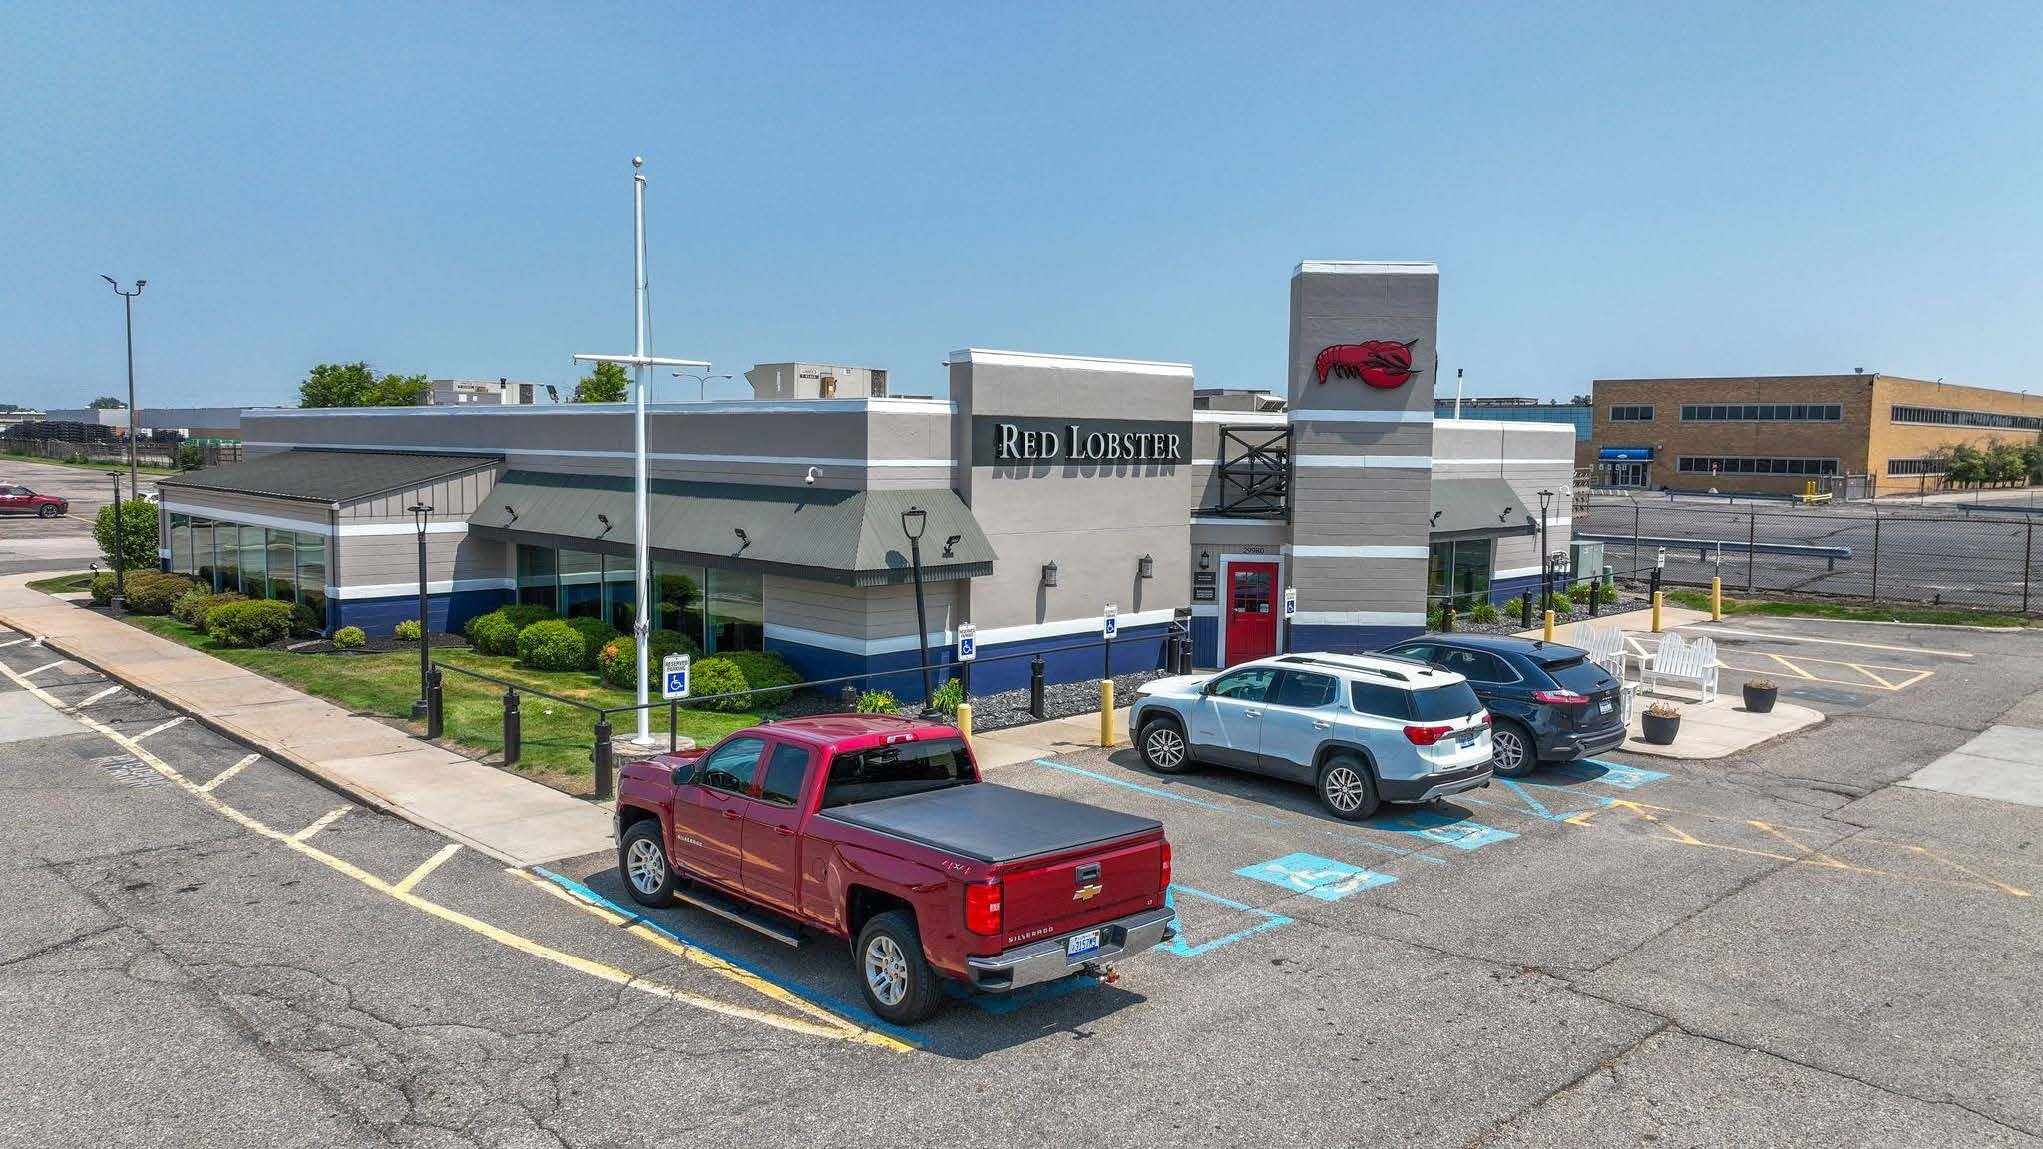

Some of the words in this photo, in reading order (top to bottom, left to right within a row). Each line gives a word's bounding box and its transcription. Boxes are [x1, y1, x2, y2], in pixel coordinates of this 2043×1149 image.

[999, 423, 1059, 459] RED
[1070, 425, 1182, 460] LOBSTER
[1008, 926, 1054, 943] SILVERADO
